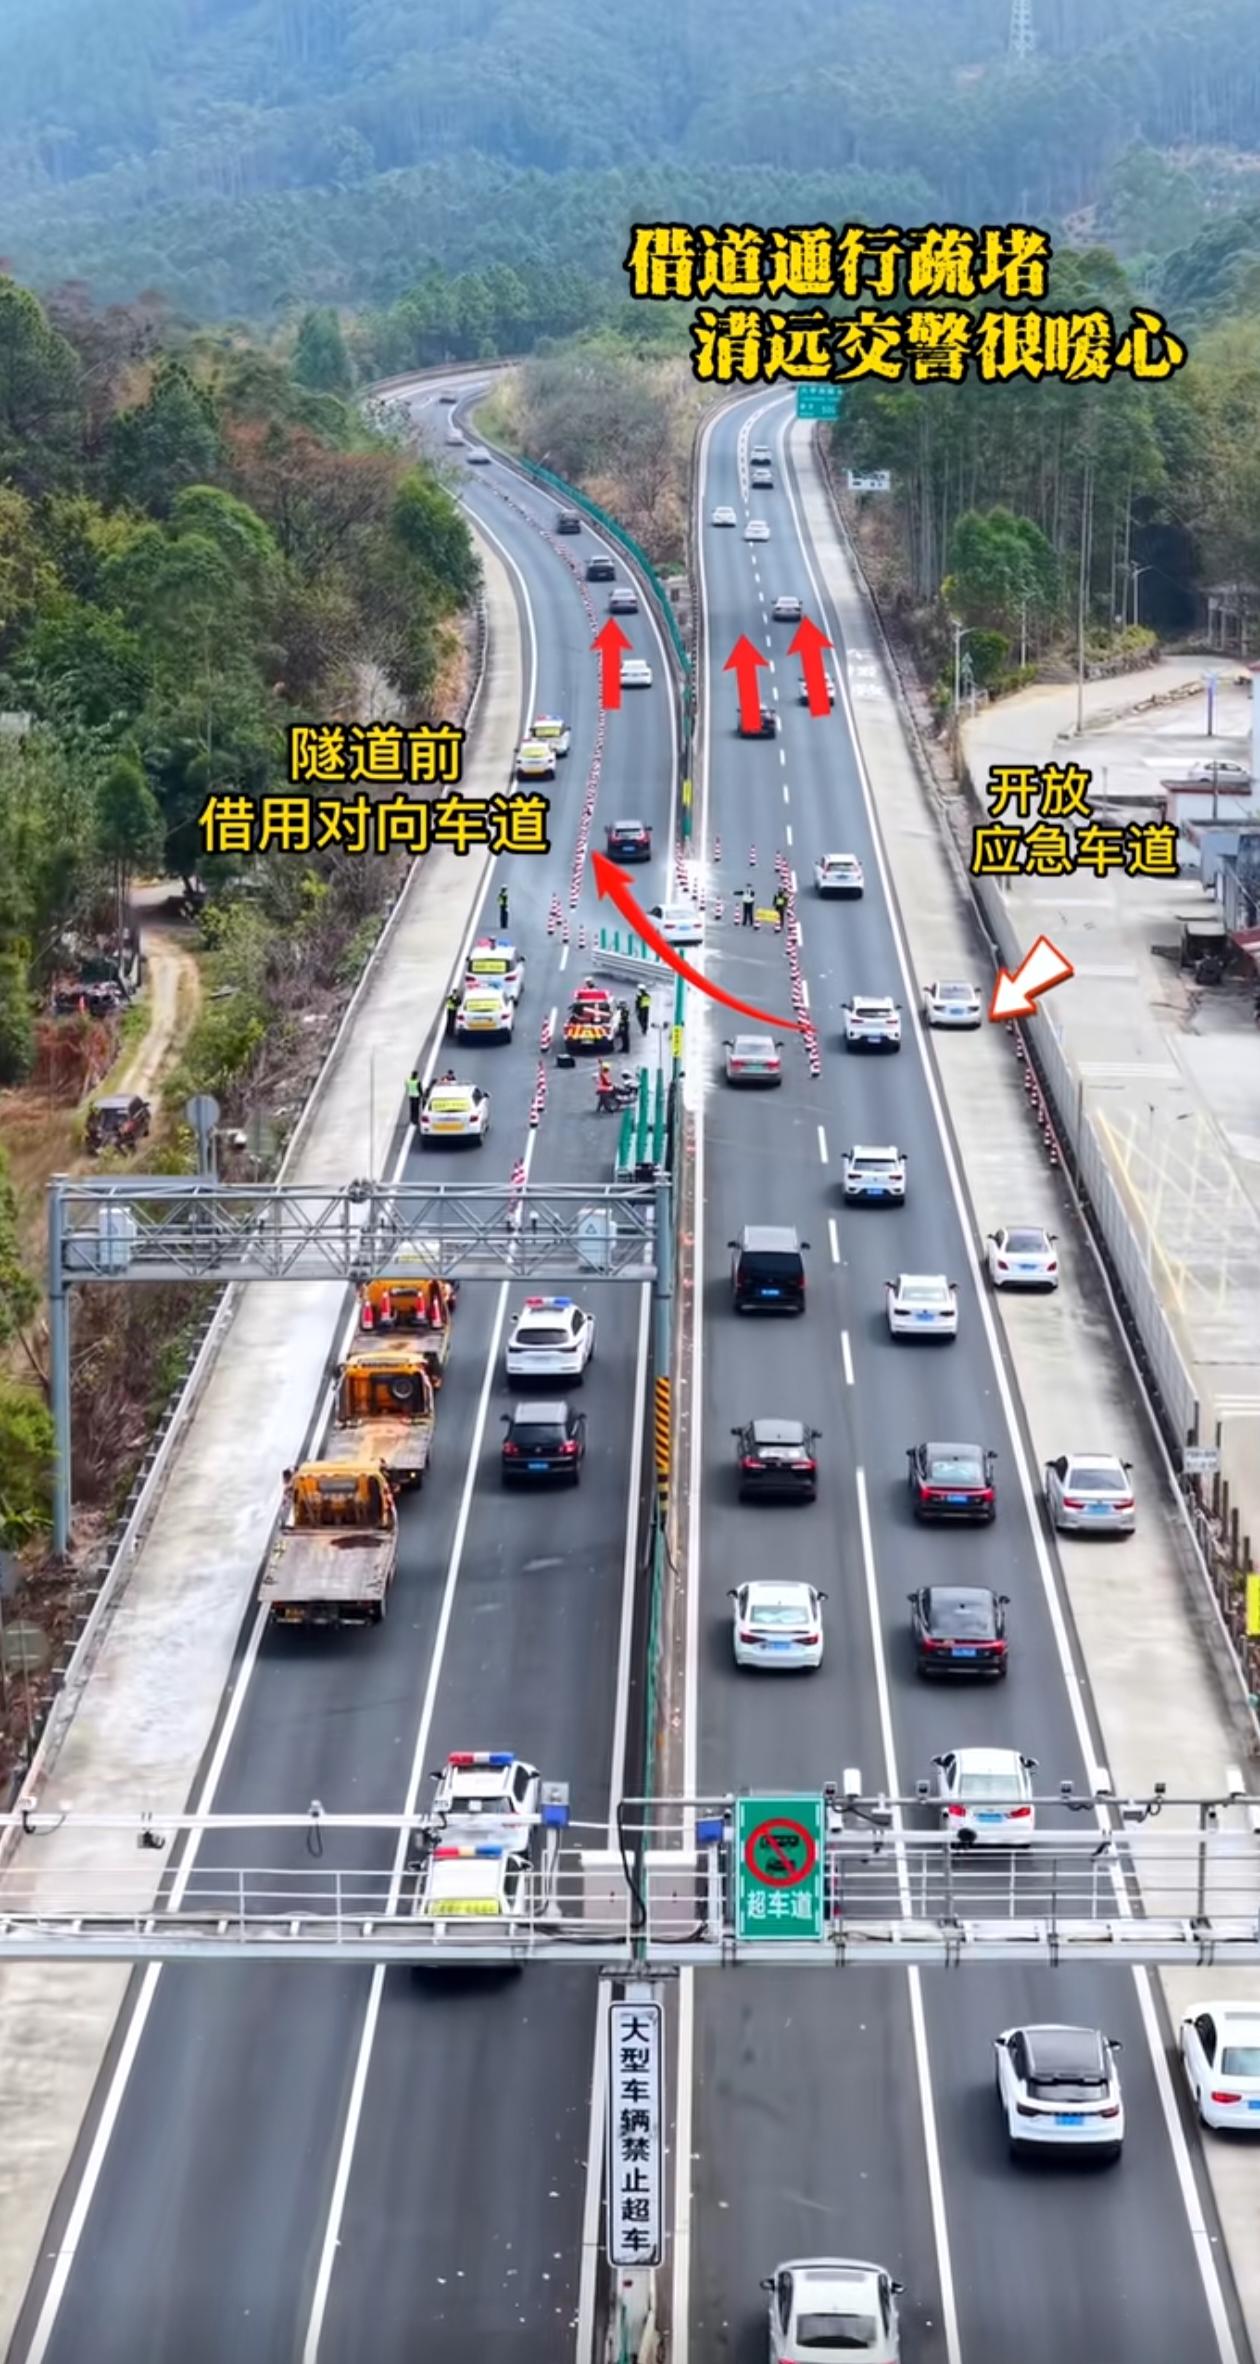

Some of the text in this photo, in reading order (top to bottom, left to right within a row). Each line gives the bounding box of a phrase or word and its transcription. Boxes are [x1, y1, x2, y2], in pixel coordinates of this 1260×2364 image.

[746, 1889, 813, 1920] 超车道
[619, 2015, 651, 2253] 大型车辆禁止超车
